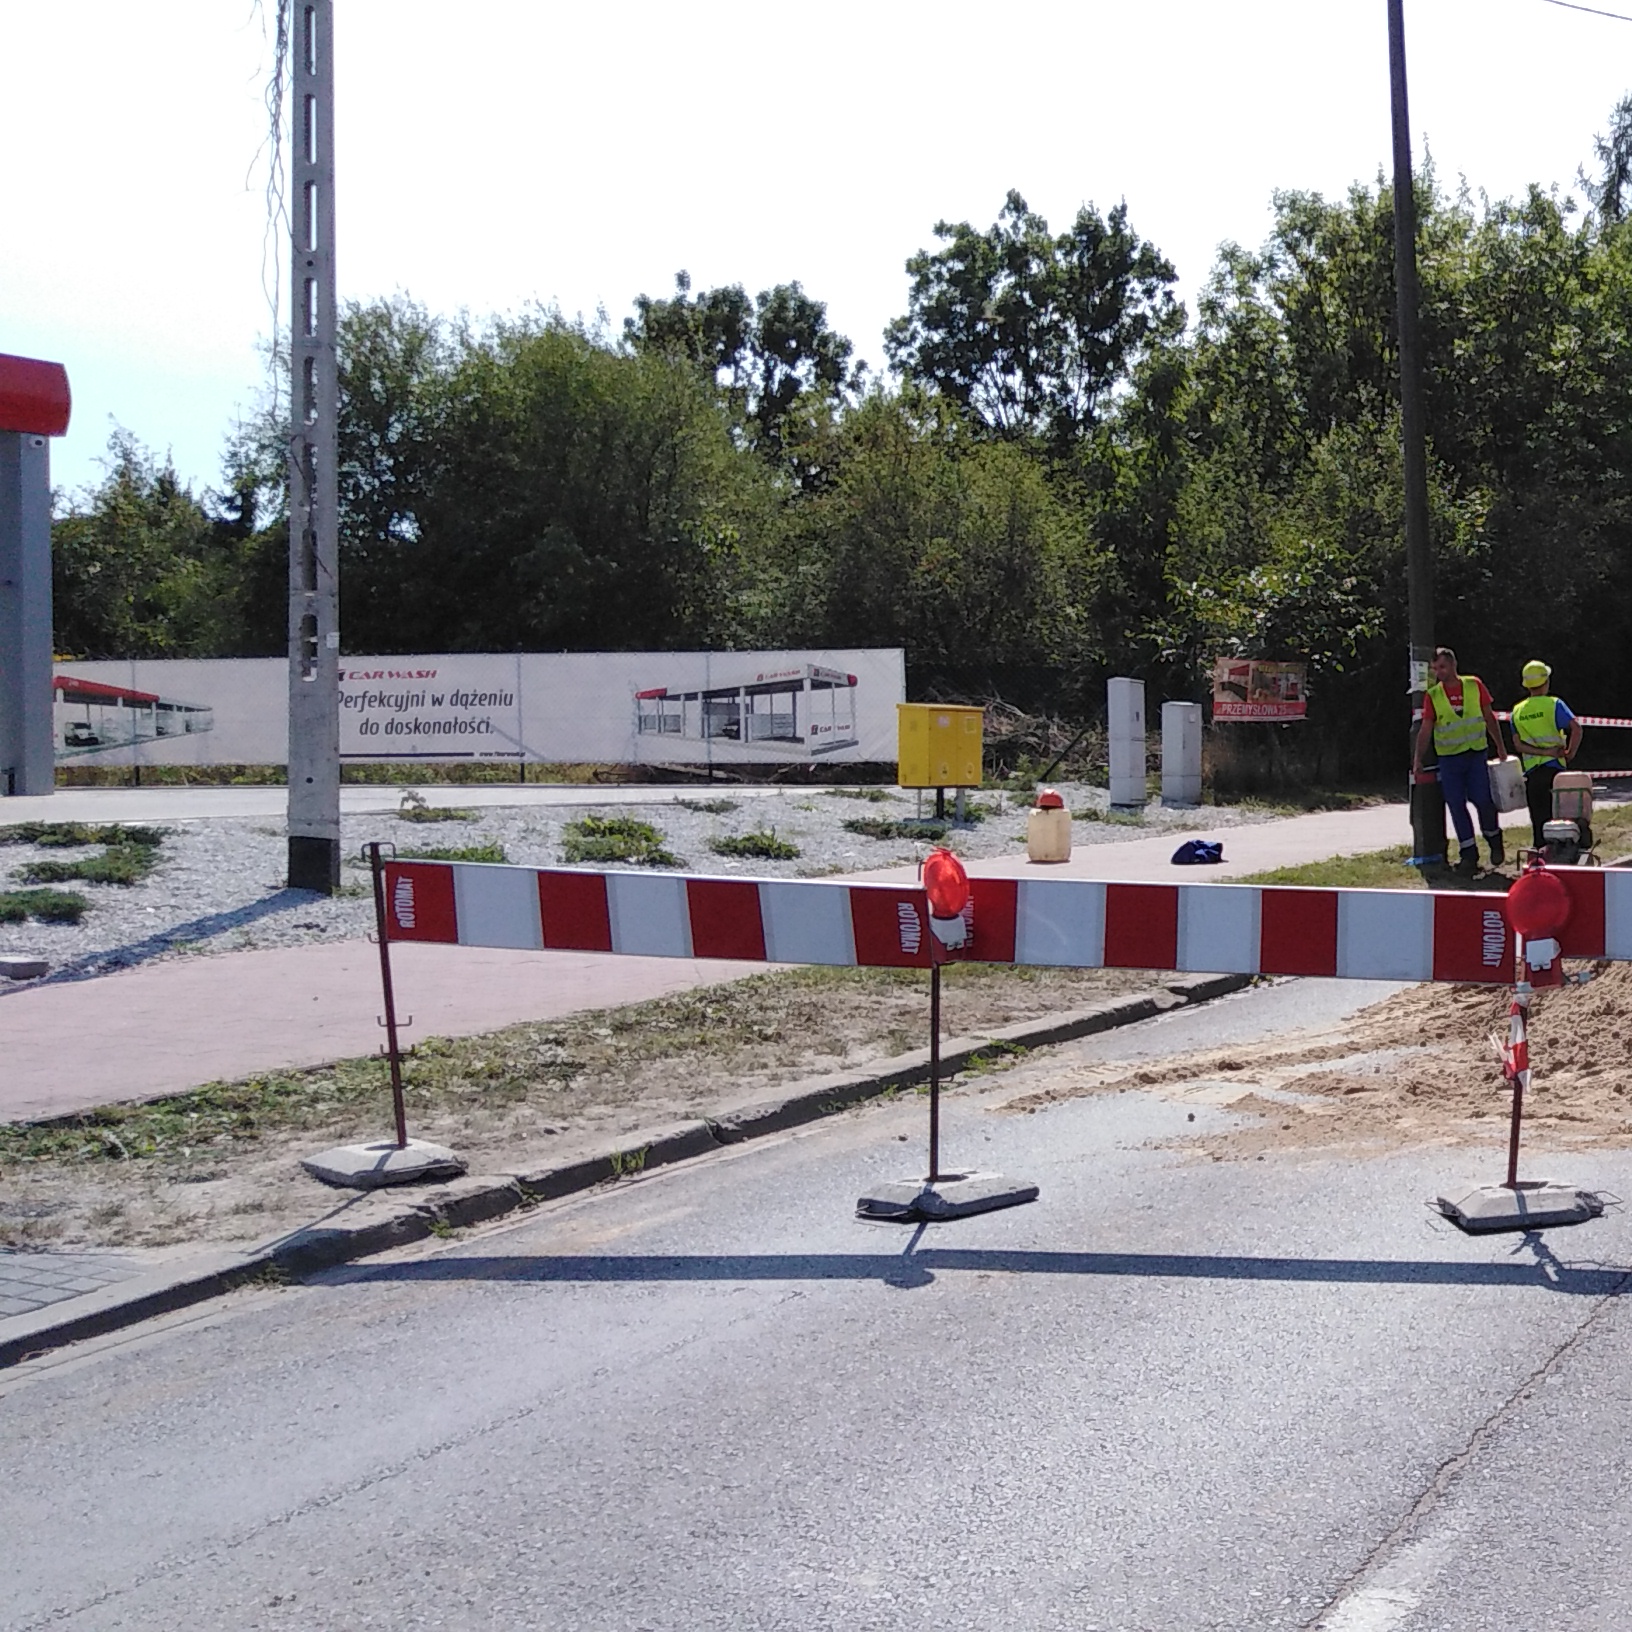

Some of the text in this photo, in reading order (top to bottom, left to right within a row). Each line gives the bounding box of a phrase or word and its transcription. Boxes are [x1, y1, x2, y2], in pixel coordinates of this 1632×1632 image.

[349, 670, 438, 680] CAR WASH
[431, 694, 445, 707] w
[450, 689, 514, 710] dążeniu
[360, 717, 495, 736] do doskonałości.
[394, 876, 415, 928] ROTOMAT
[897, 902, 922, 955] ROTOMAT
[1483, 910, 1506, 968] ROTOMAT
